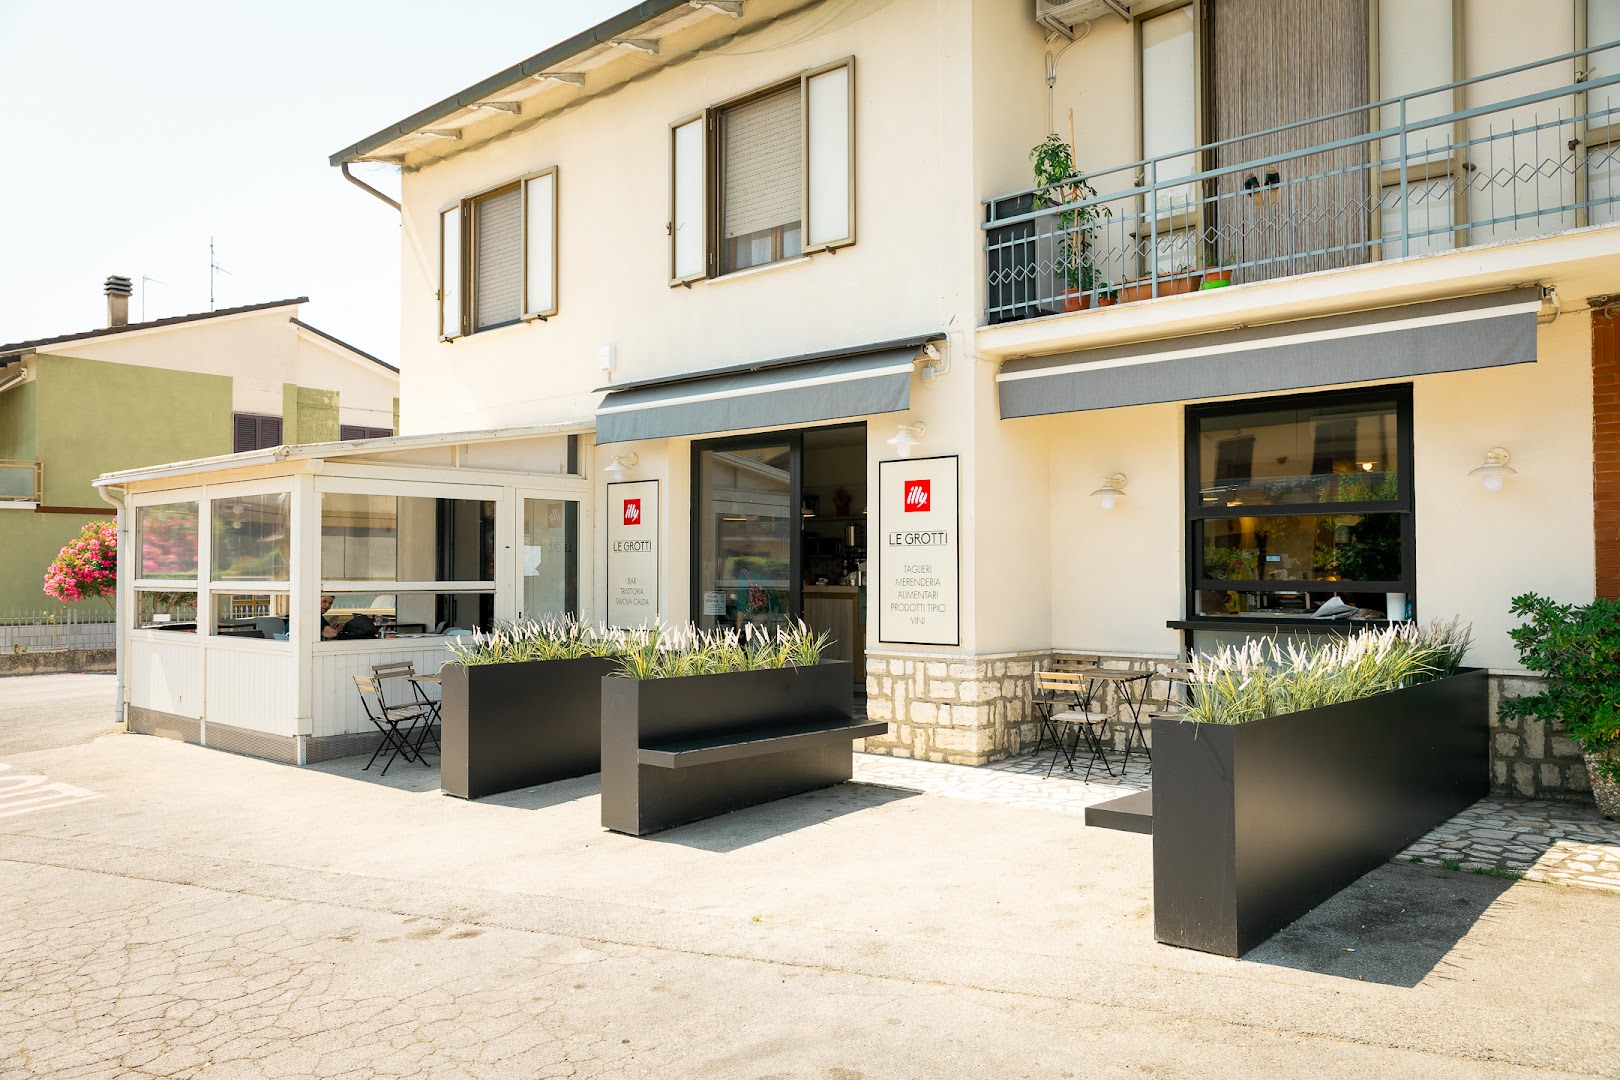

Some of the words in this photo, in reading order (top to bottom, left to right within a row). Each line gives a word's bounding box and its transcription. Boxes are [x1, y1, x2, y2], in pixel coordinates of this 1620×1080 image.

[906, 486, 927, 507] illy
[624, 504, 639, 521] illy
[889, 533, 901, 544] LE
[904, 532, 947, 544] GROTTI
[613, 541, 621, 551] LE
[623, 541, 651, 551] GROTTI
[903, 564, 932, 573] TAGLIERI
[895, 577, 940, 586] MERENDERIA
[620, 587, 643, 595] TRATTORIA
[897, 590, 938, 598] ALIMENTARI
[615, 597, 631, 605] TAVOLA
[633, 597, 648, 605] CALDA
[890, 602, 925, 612] PRODOTTI
[927, 602, 946, 612] TIPICI
[910, 616, 925, 624] VINI
